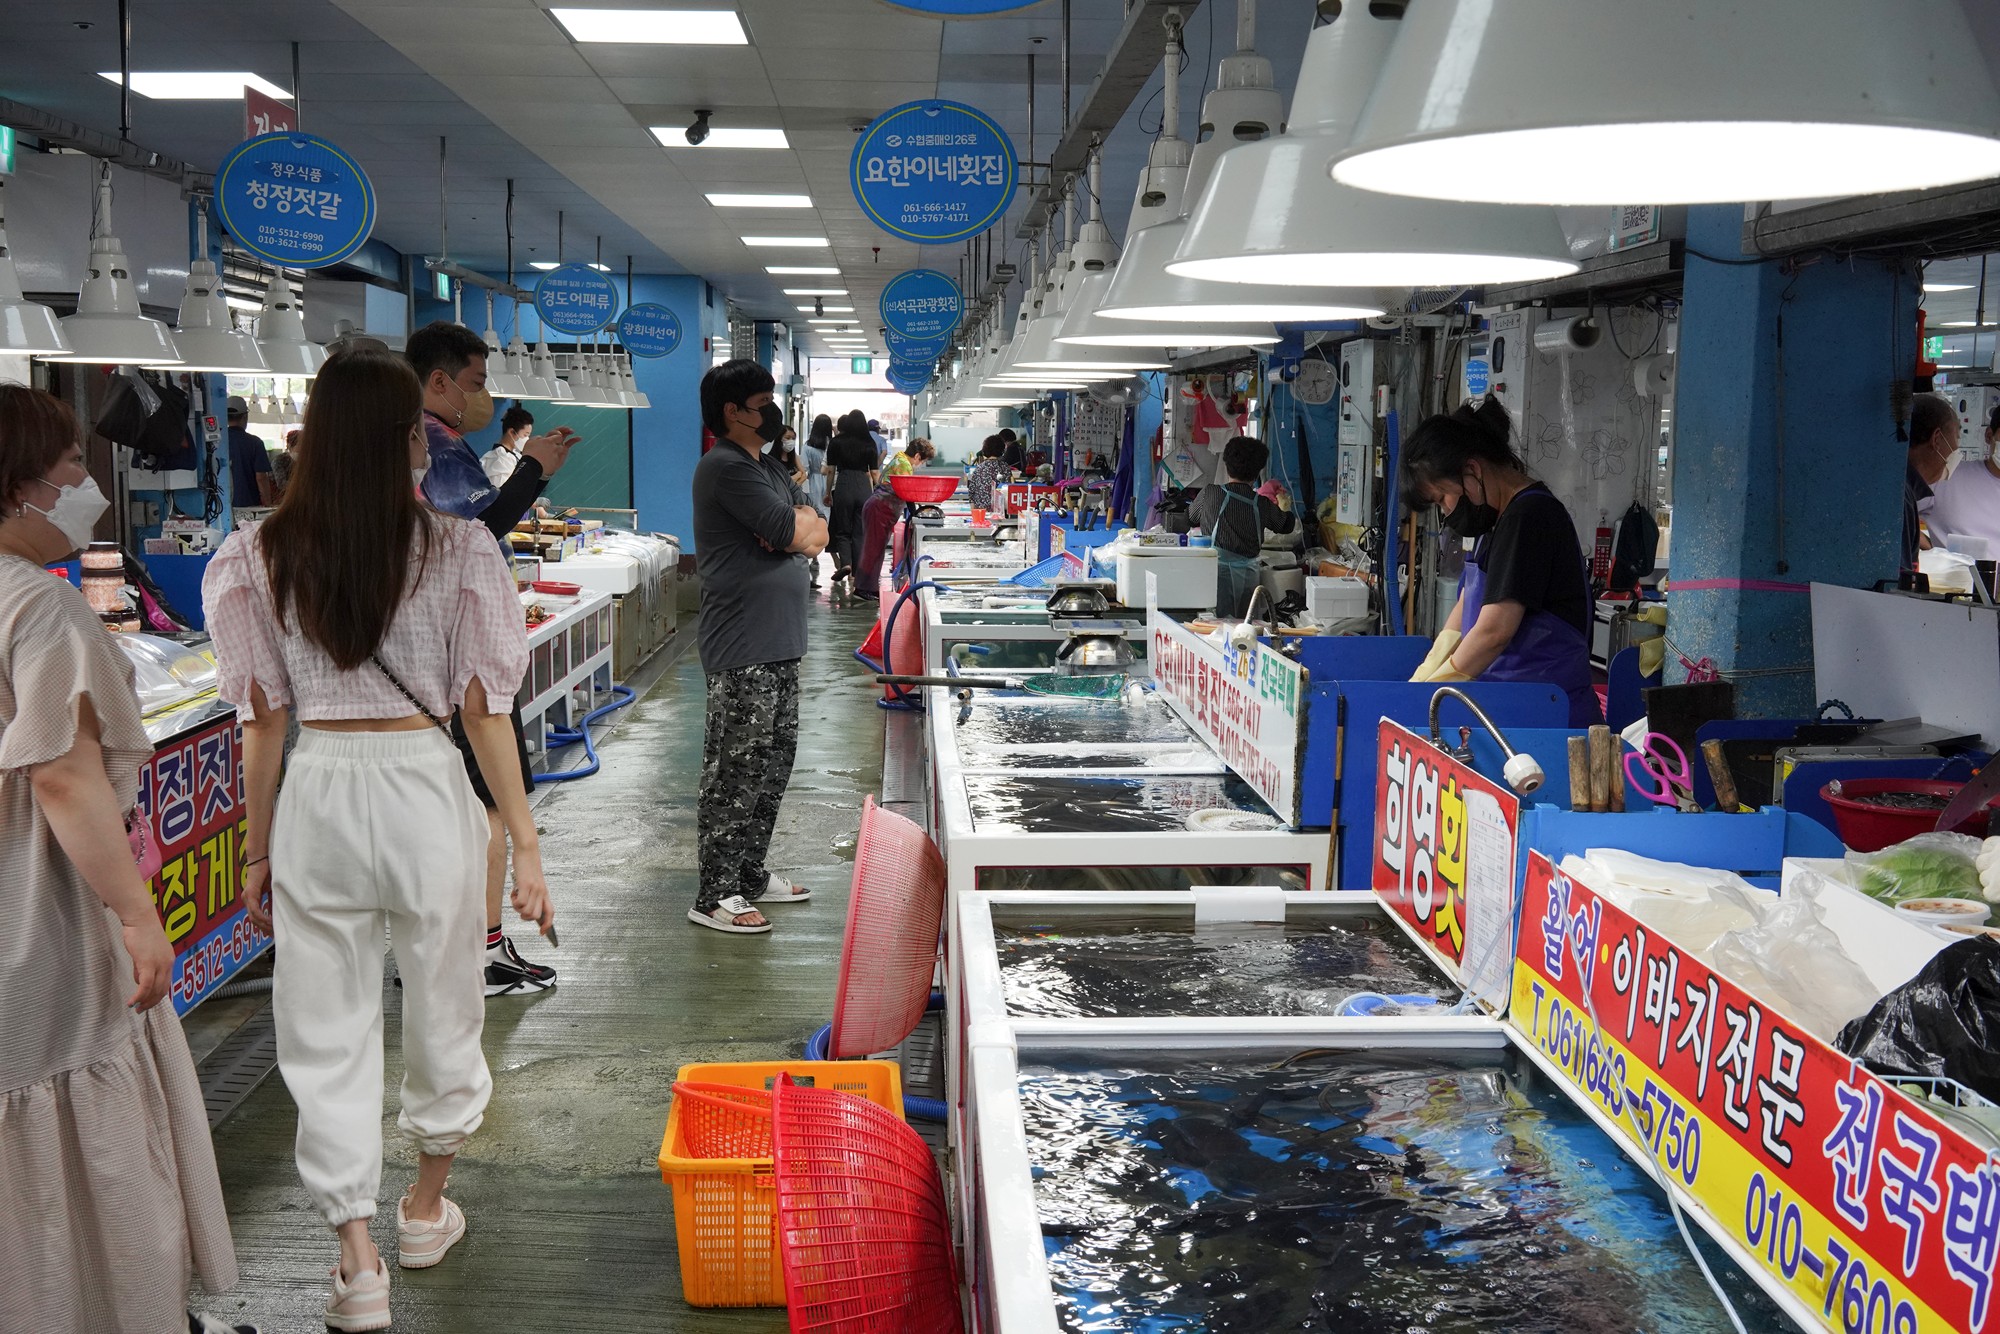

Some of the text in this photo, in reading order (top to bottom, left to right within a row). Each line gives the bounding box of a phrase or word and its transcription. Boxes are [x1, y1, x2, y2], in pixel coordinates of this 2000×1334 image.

[270, 162, 323, 183] 정우식품
[863, 153, 1004, 187] 요한이네횟집
[245, 179, 343, 221] 청정젓갈
[903, 203, 967, 213] 061-666-1417
[901, 213, 970, 223] 010-5767-4171
[257, 235, 323, 252] 010-3621-6990
[258, 225, 324, 242] 010-5512-6990
[542, 290, 610, 310] 경도어패류
[623, 322, 677, 340] 광희네선어
[137, 723, 246, 845] 정젓
[1382, 738, 1469, 954] 희영횟
